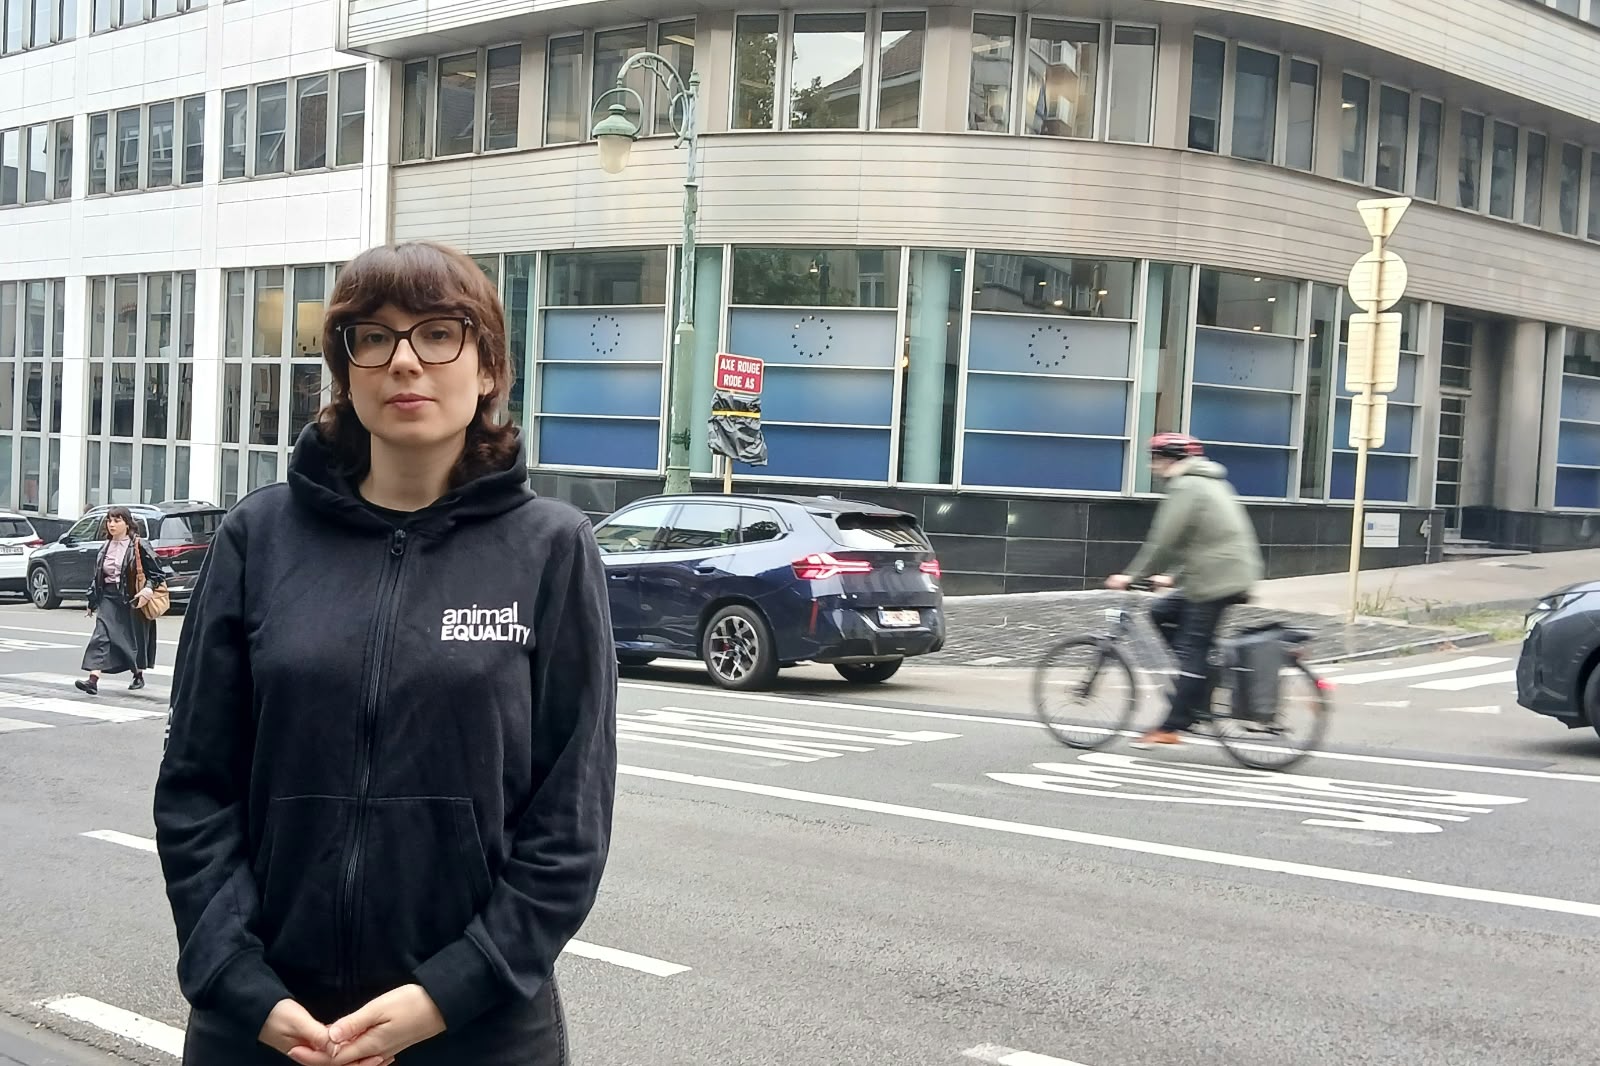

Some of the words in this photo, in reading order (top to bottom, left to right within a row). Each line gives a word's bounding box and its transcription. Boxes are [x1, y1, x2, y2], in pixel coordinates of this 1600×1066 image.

[720, 358, 735, 371] AXE
[737, 360, 761, 375] ROUGE
[723, 374, 743, 388] RODE
[744, 377, 755, 390] AS
[442, 601, 518, 625] animal
[984, 753, 1529, 833] BUS
